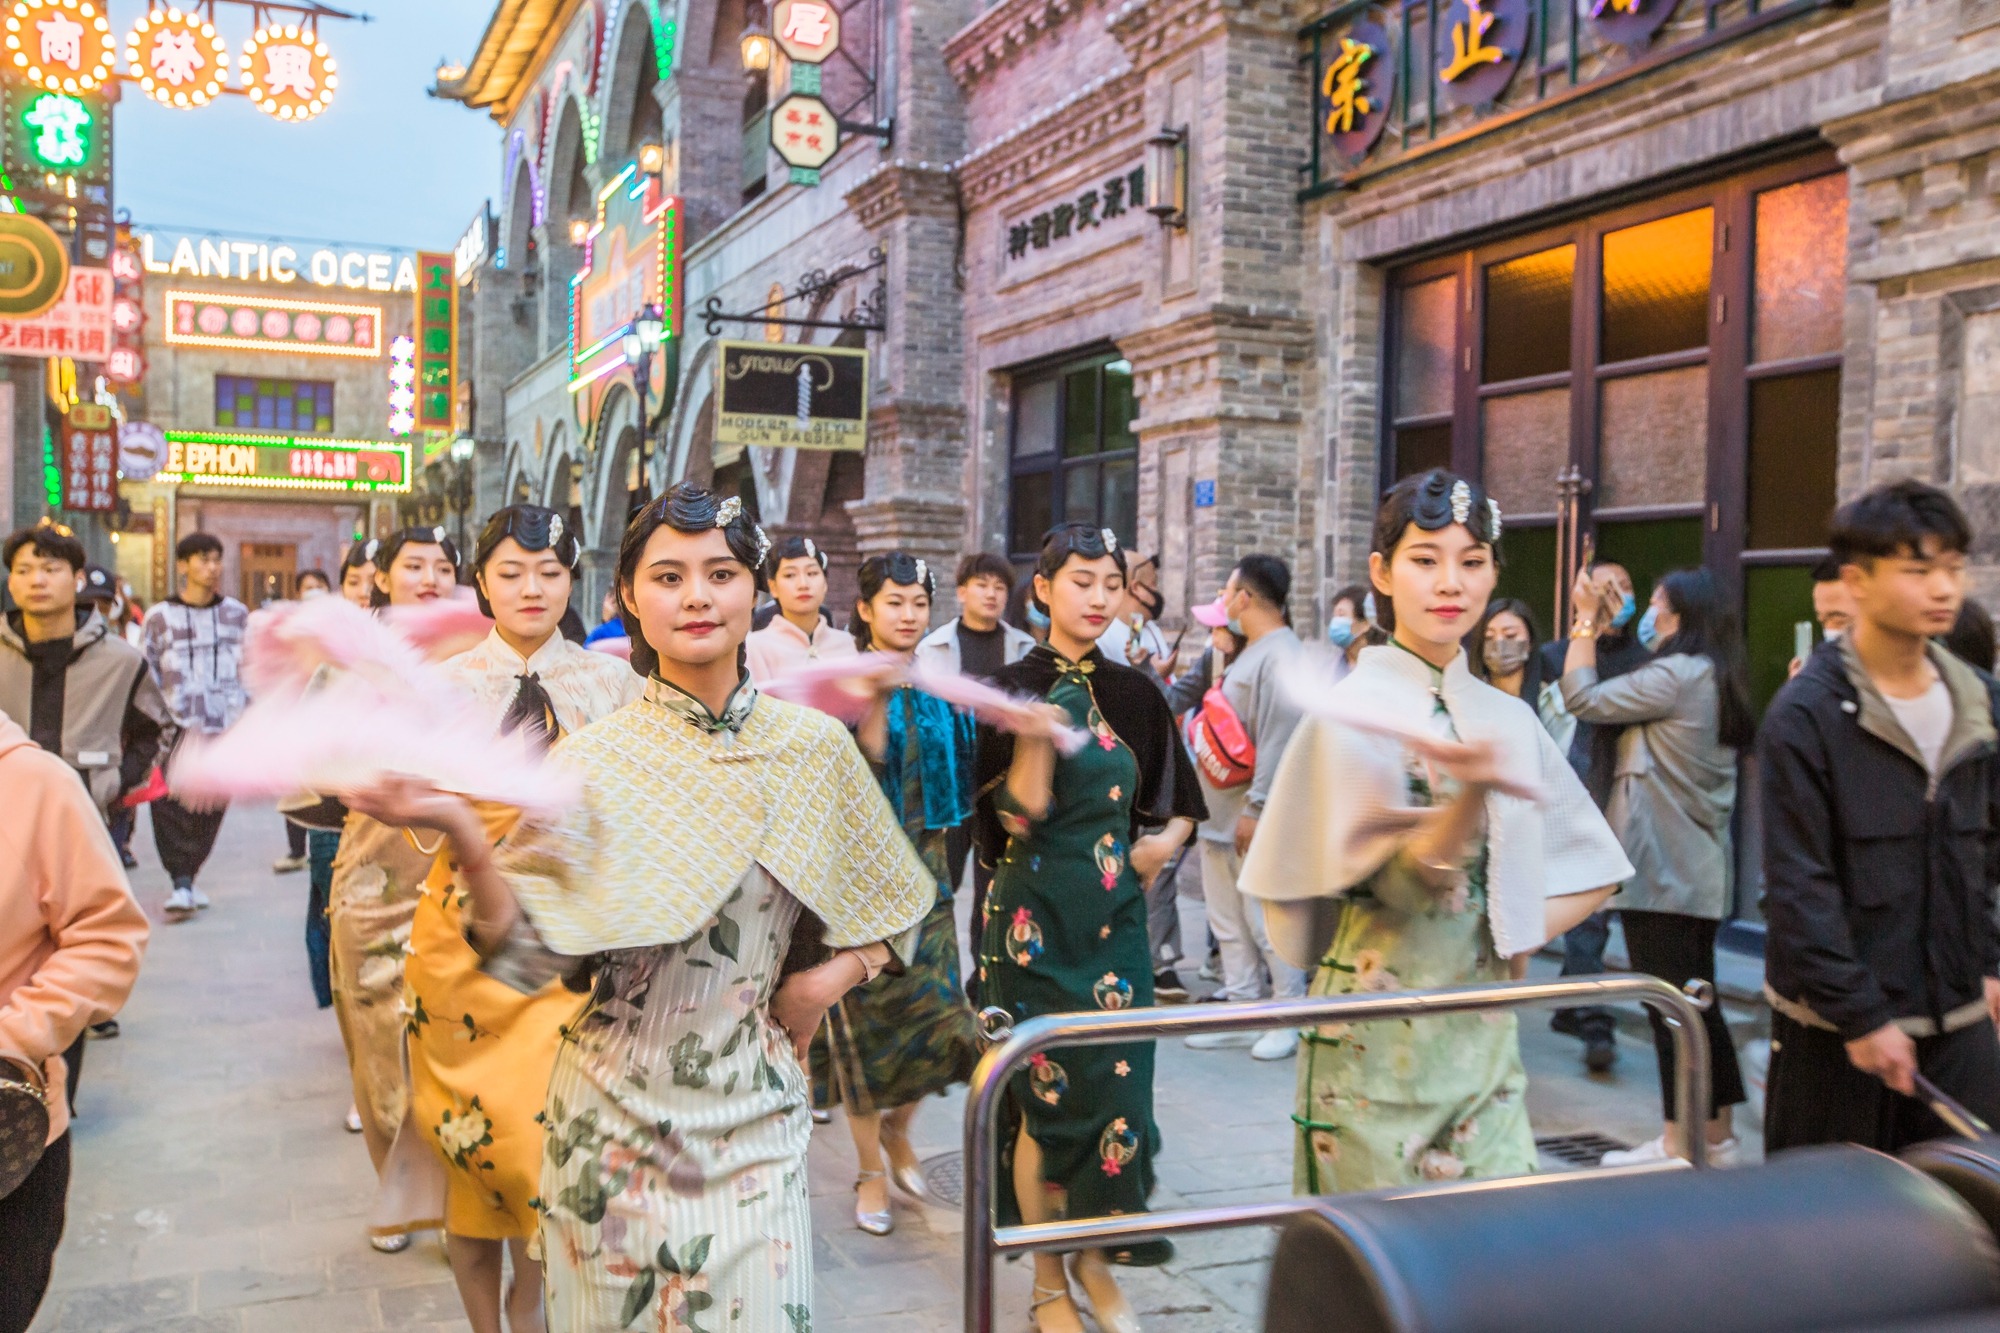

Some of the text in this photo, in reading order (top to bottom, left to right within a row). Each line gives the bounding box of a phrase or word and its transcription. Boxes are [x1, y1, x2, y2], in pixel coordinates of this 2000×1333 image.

[142, 233, 418, 293] LANTIC OCEA
[1194, 720, 1231, 783] WILSON
